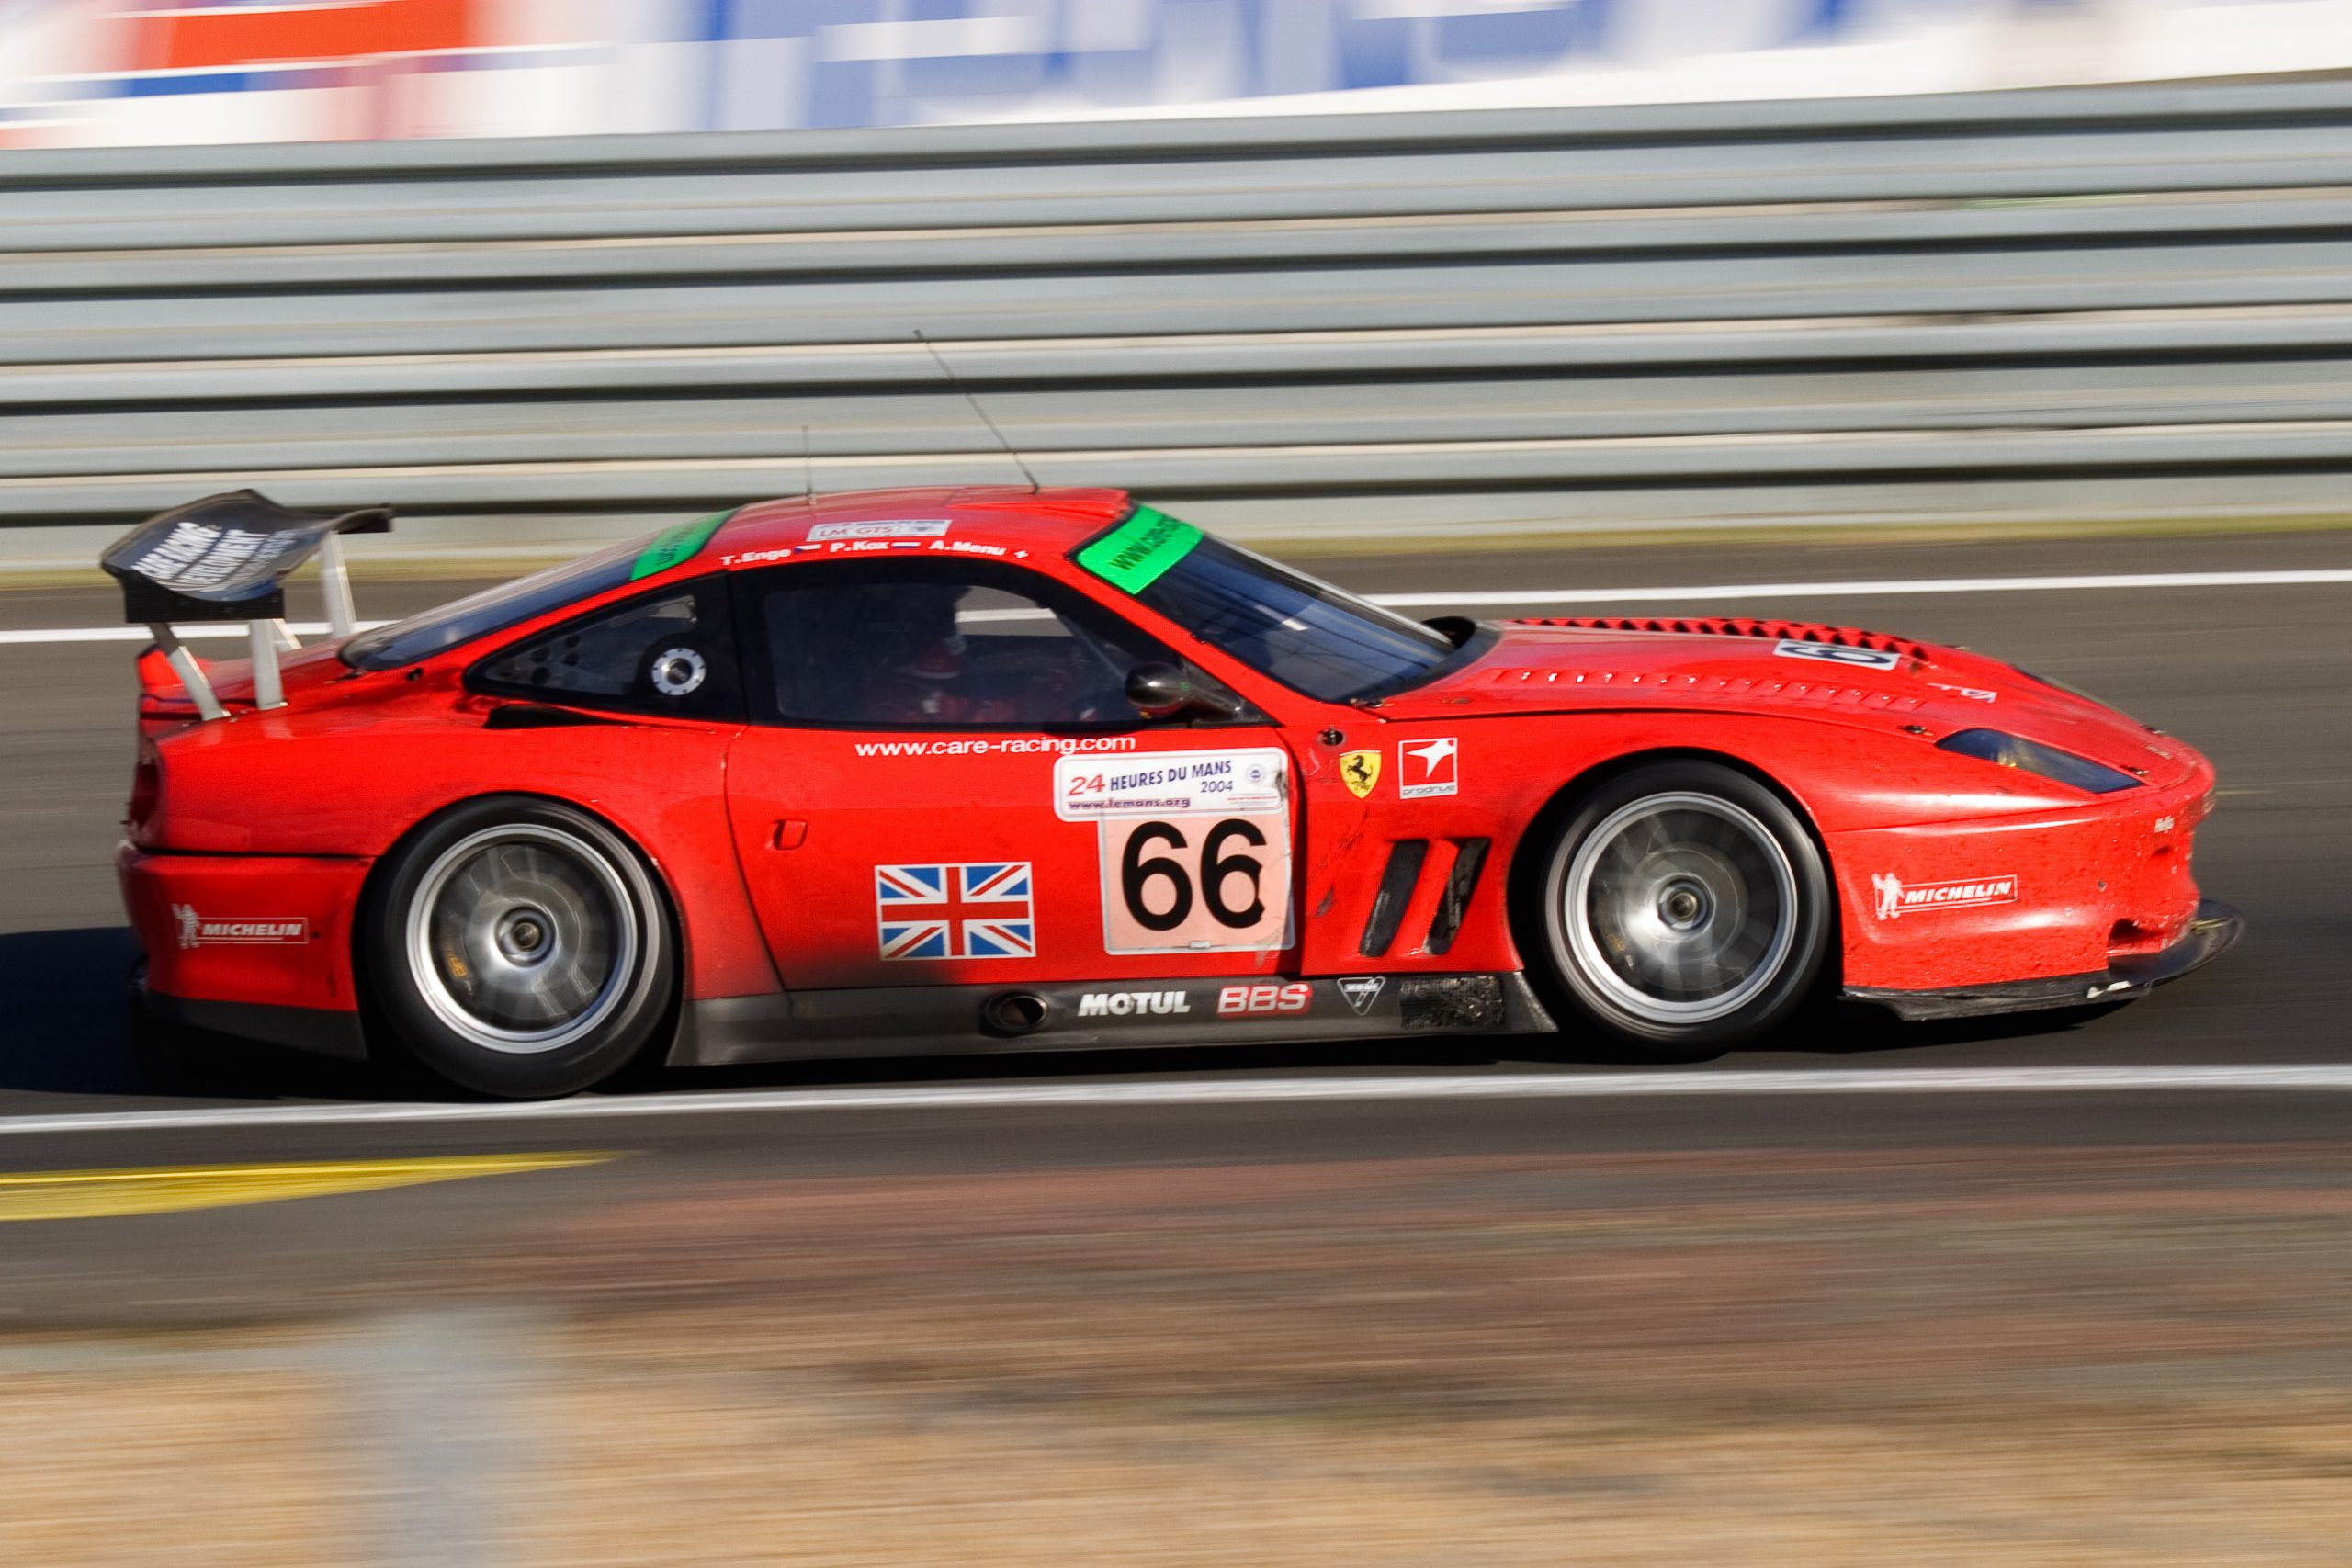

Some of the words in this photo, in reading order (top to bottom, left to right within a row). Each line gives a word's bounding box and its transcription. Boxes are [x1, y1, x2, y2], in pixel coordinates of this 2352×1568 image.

[854, 737, 1136, 756] www.care-racing.com
[1068, 774, 1105, 796] 24
[1110, 770, 1163, 792] HEURES
[1168, 766, 1187, 783] DU
[1192, 760, 1232, 778] MANS
[1200, 780, 1233, 793] 2004
[1067, 797, 1191, 809] www.lemans.org
[1122, 818, 1267, 931] 66
[1904, 882, 2012, 904] MICHELIN
[202, 924, 302, 935] MICHELIN
[1078, 991, 1191, 1016] MOTUL
[1216, 984, 1309, 1013] BBS
